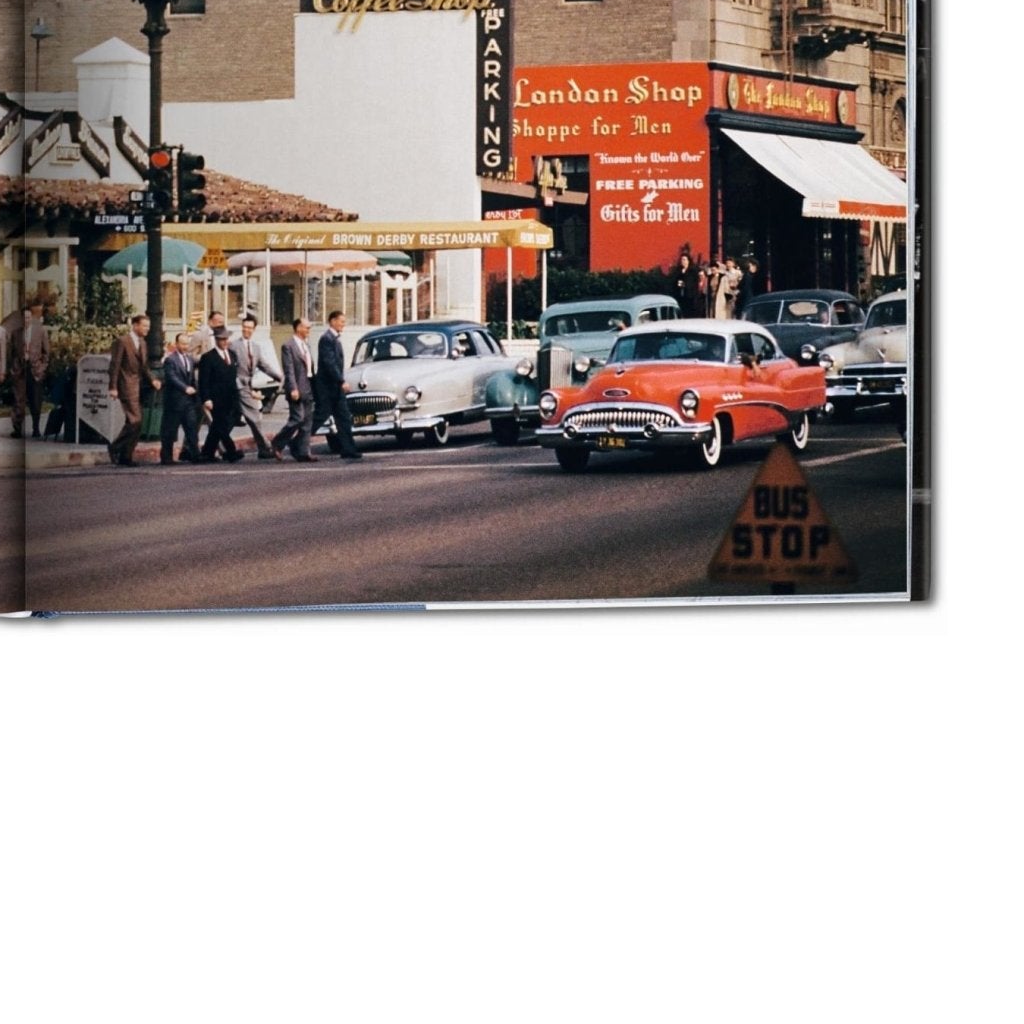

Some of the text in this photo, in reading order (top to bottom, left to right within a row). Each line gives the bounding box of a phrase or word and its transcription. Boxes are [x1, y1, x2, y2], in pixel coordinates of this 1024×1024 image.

[481, 8, 505, 18] FREE
[483, 17, 503, 167] PARKING
[513, 75, 702, 108] London Shop
[743, 78, 761, 104] The
[806, 87, 831, 119] Shop
[591, 116, 621, 136] for
[630, 115, 672, 136] Men
[634, 152, 648, 163] the
[650, 152, 679, 163] World
[596, 178, 704, 191] FREE PARKING
[600, 202, 700, 225] Gifts for Men
[283, 234, 327, 248] Original
[332, 233, 372, 246] BROWN
[377, 234, 415, 246] DERBY
[420, 231, 499, 245] RESTAURANT
[753, 484, 810, 519] BUS
[732, 523, 830, 559] STOP
